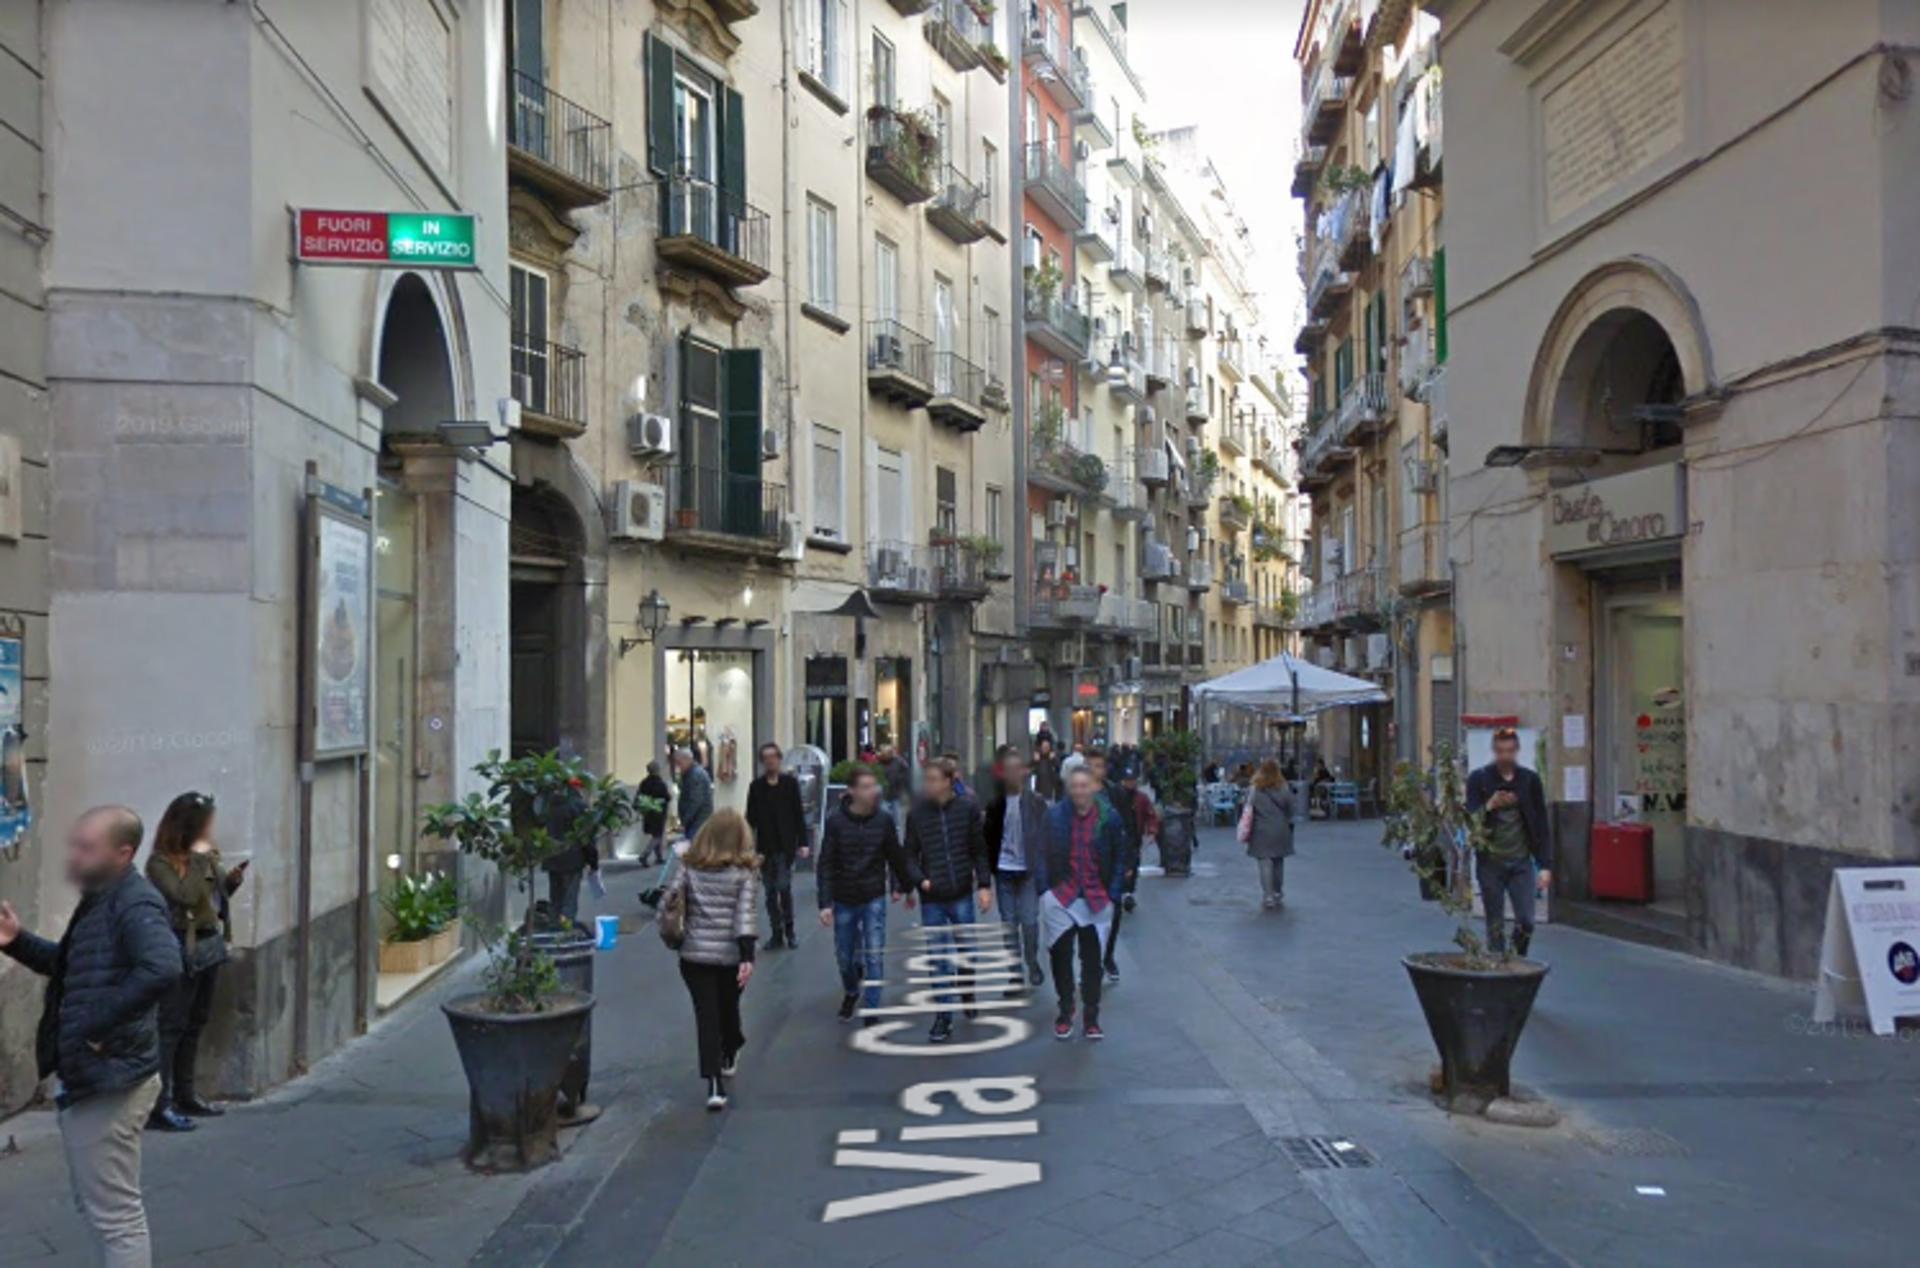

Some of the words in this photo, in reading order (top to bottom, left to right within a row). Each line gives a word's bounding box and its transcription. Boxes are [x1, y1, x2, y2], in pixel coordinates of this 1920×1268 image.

[317, 217, 371, 233] FUORI
[422, 220, 440, 235] IN
[304, 235, 384, 254] SERVIZIO
[391, 239, 471, 258] SERVIZIO
